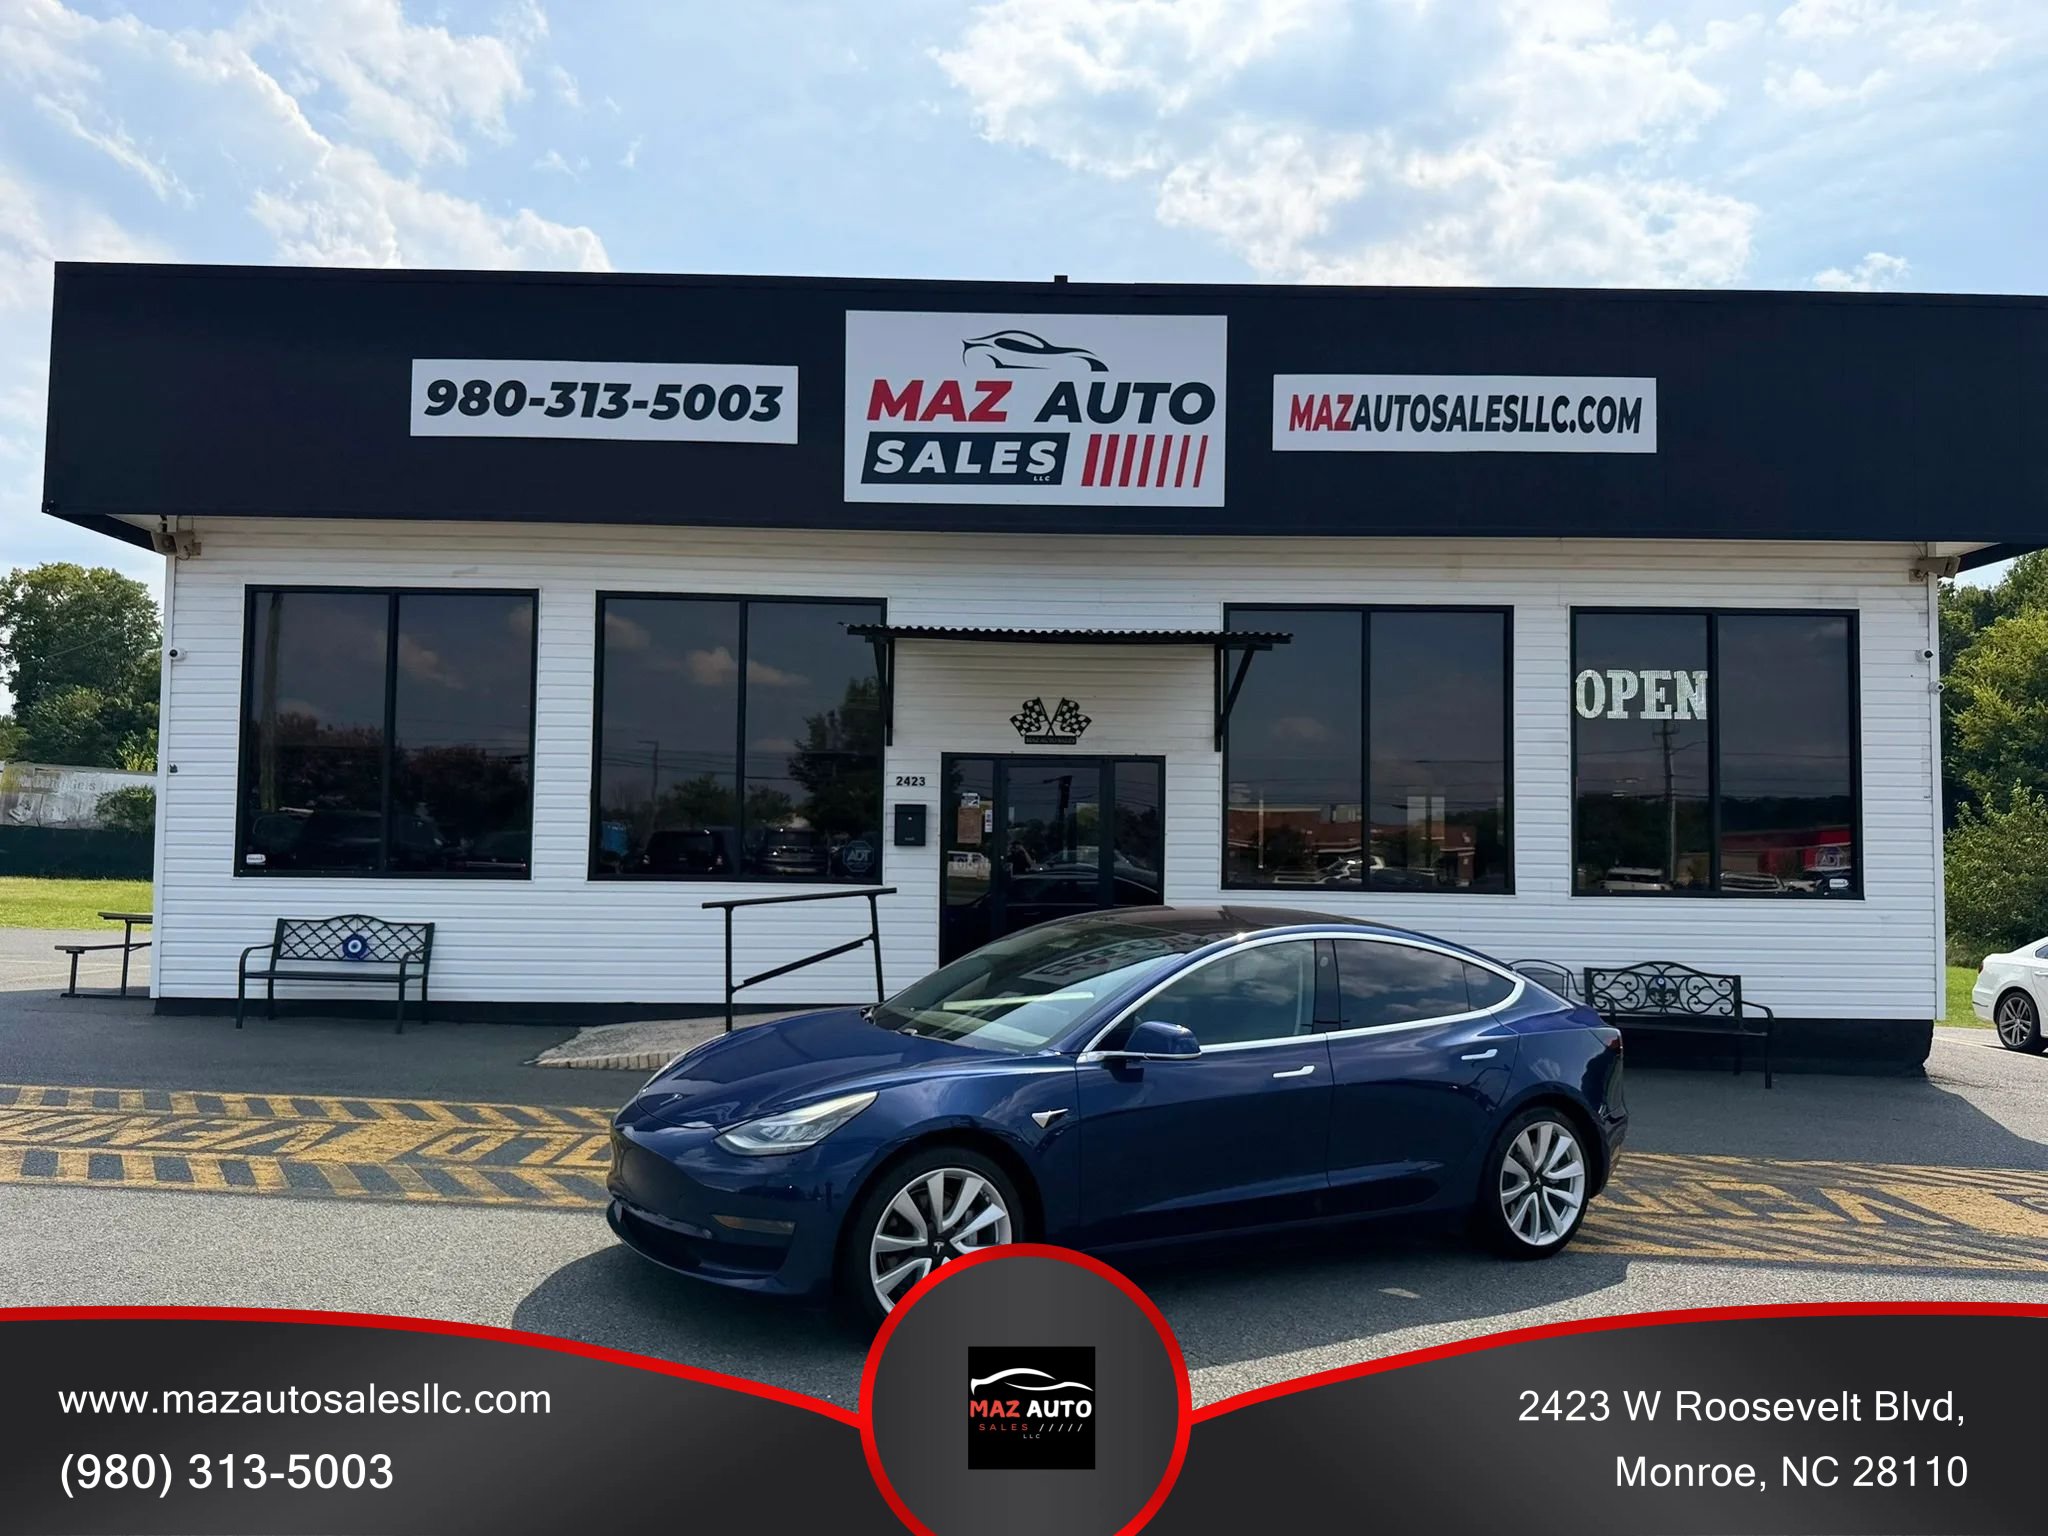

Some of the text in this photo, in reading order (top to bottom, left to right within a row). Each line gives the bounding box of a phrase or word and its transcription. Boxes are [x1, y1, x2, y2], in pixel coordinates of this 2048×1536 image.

[423, 378, 784, 423] 980-313-5003
[866, 379, 1216, 425] MAZ AUTO
[1288, 394, 1643, 434] MAZAUTOSALESLLC.COM
[873, 440, 1058, 475] SALES
[1575, 669, 1708, 720] OPEN
[896, 775, 926, 787] 2423
[847, 849, 872, 861] ADT
